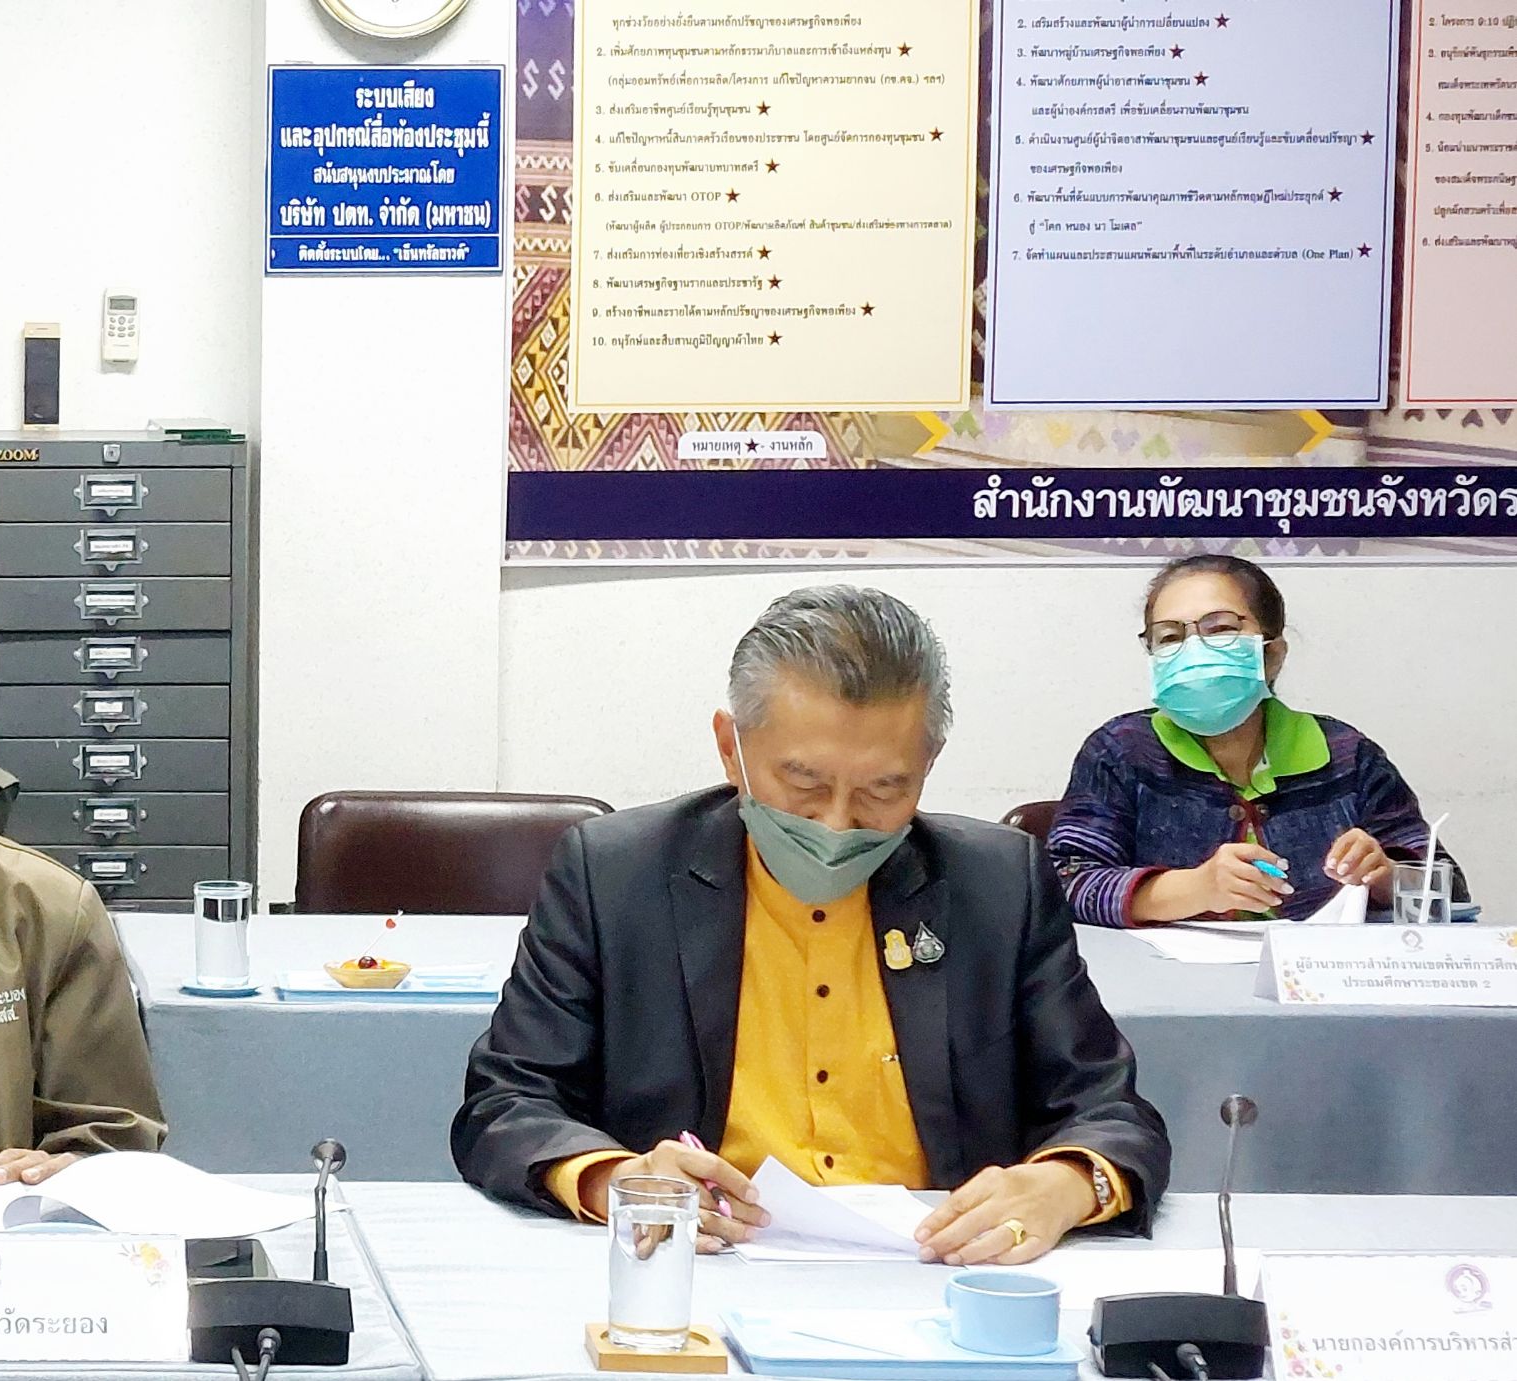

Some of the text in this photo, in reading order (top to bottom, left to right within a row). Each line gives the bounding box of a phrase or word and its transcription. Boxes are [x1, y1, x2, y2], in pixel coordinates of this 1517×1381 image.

[1017, 19, 1027, 29] 2.
[597, 47, 607, 56] 2.
[1017, 48, 1028, 58] 3.
[1016, 76, 1026, 87] 4.
[355, 81, 435, 109] ระบบเสียง
[596, 105, 606, 114] 3.
[280, 112, 491, 157] และอุปกรณ์สื่อห้องประชุมนี้
[595, 135, 605, 143] 4.
[1015, 135, 1024, 144] 5.
[595, 163, 605, 173] 5.
[313, 160, 455, 189] สนับสนุนงบประมาณโดย
[595, 193, 605, 201] 6.
[691, 192, 721, 201] OTOP
[1013, 193, 1023, 203] 6.
[280, 197, 325, 226] บริษัท
[380, 196, 420, 226] จำกัด
[426, 200, 491, 229] (มหาชน)
[593, 250, 603, 259] 7.
[1012, 250, 1021, 261] 7.
[1299, 248, 1326, 260] (One
[1328, 248, 1353, 262] Plan)
[593, 279, 603, 288] 8.
[592, 308, 602, 317] 9.
[593, 337, 607, 346] 10.
[692, 440, 741, 455] หมายเหตุ
[769, 436, 813, 452] งานหลัก
